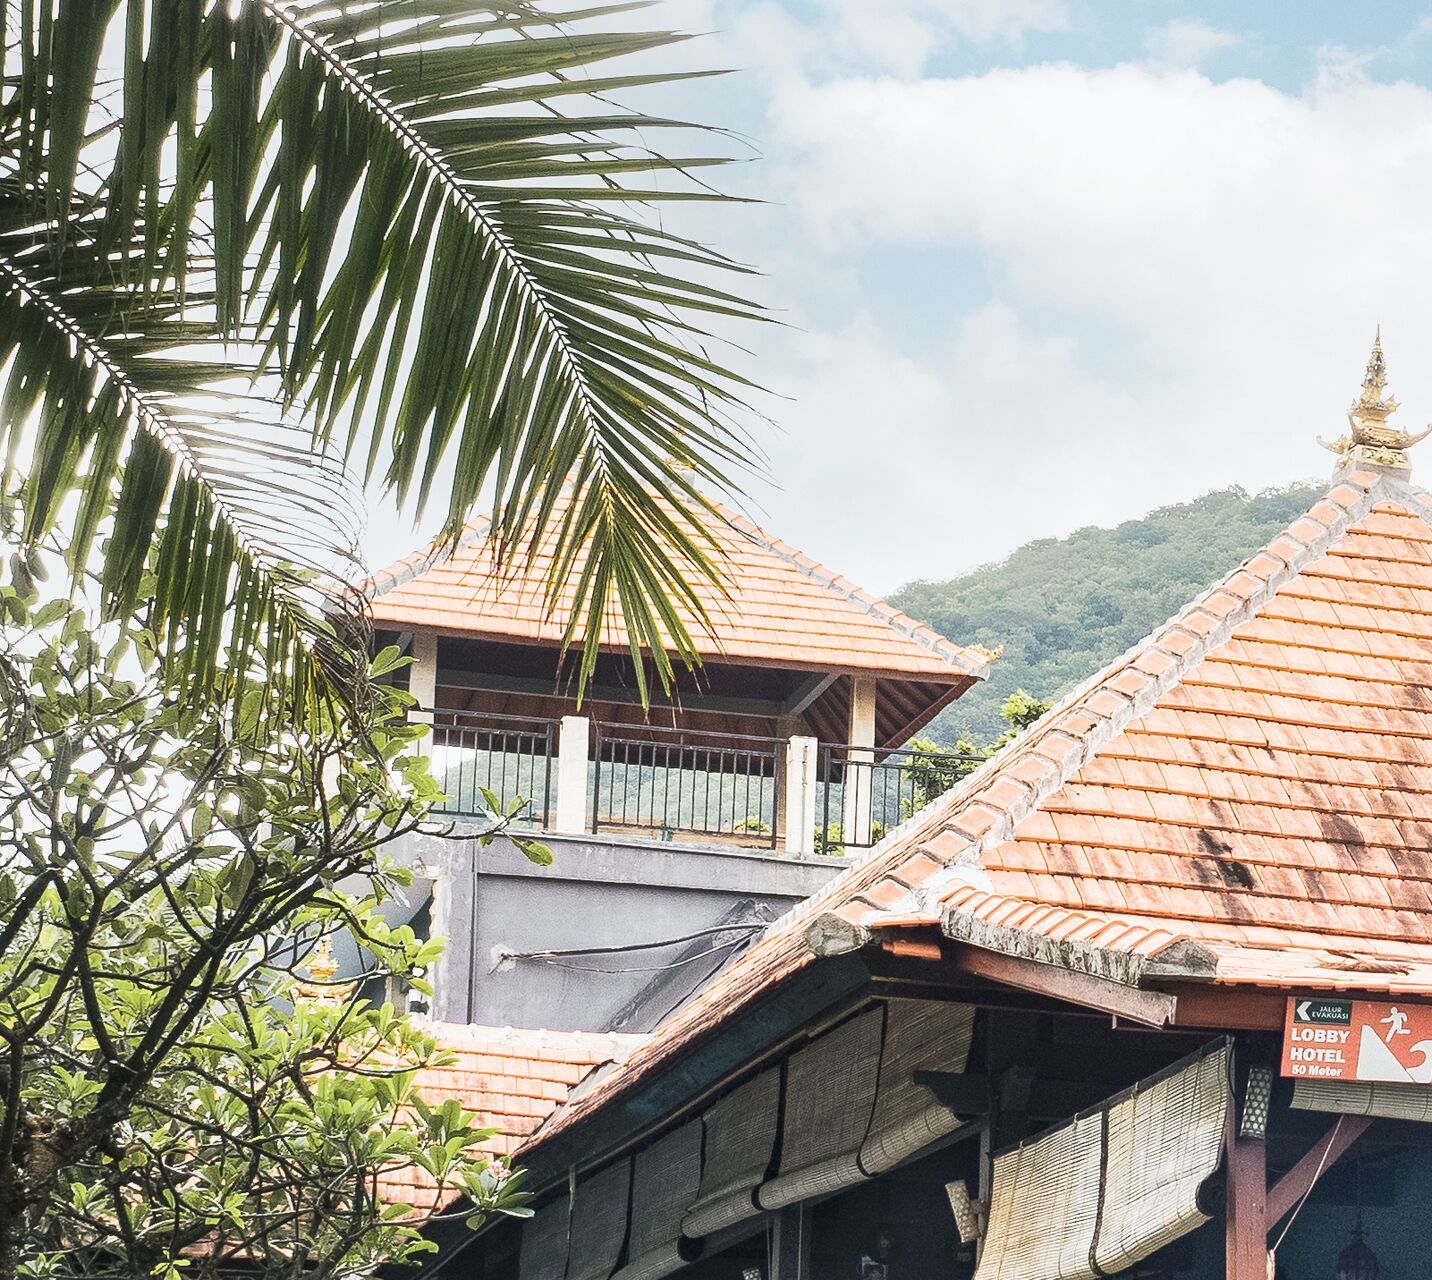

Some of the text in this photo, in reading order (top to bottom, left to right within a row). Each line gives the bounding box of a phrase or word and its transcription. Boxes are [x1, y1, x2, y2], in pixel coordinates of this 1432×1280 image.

[1311, 1011, 1349, 1020] EVAKUASI
[1291, 1027, 1350, 1043] LOBBY
[1290, 1047, 1345, 1063] HOTEL
[1291, 1064, 1306, 1075] 50
